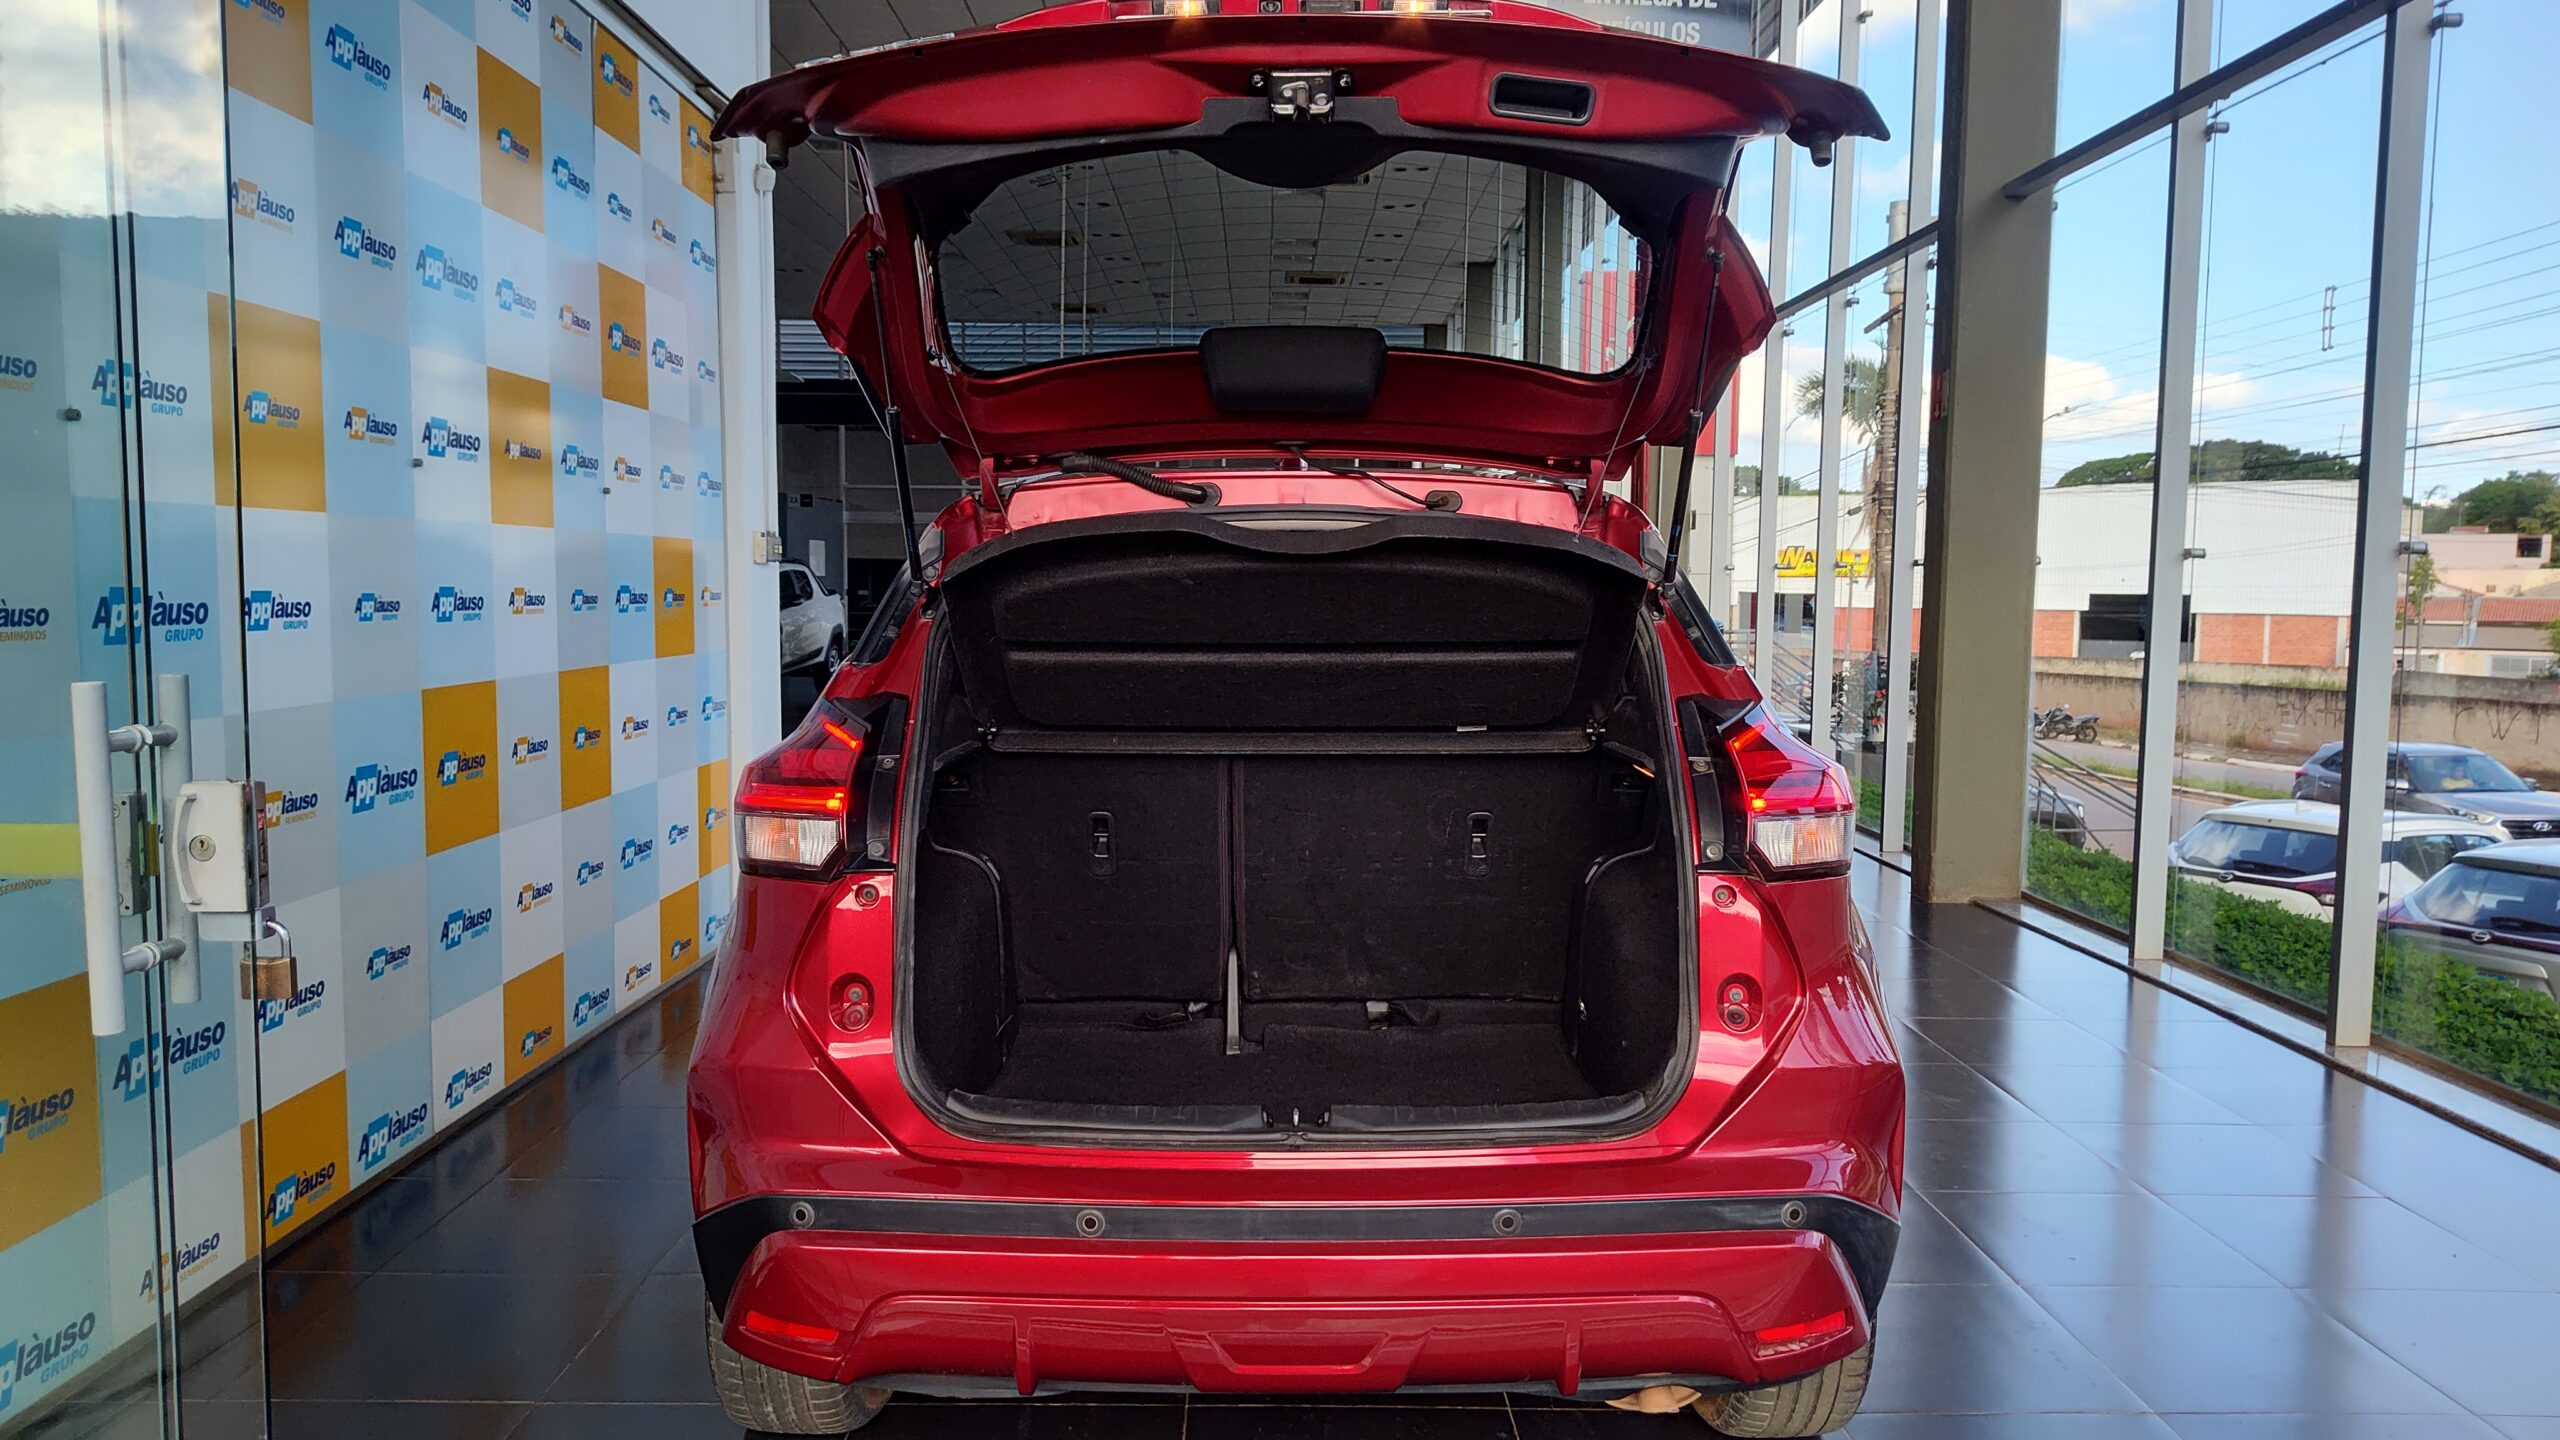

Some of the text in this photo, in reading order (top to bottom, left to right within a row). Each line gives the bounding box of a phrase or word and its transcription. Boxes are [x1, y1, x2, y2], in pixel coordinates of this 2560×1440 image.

[151, 403, 183, 417] GRUPO
[0, 598, 50, 627] àuso
[0, 630, 47, 641] EMINOVOS
[164, 628, 204, 642] GRUPO
[266, 790, 318, 828] pplàuso
[389, 790, 414, 805] GRUPO
[297, 1001, 322, 1018] GRUPO
[183, 1047, 220, 1075] GRUPO
[0, 1087, 74, 1152] làuso
[400, 1125, 424, 1148] GRUPO
[0, 1311, 95, 1406] plàuso
[40, 1344, 89, 1384] GRUPO
